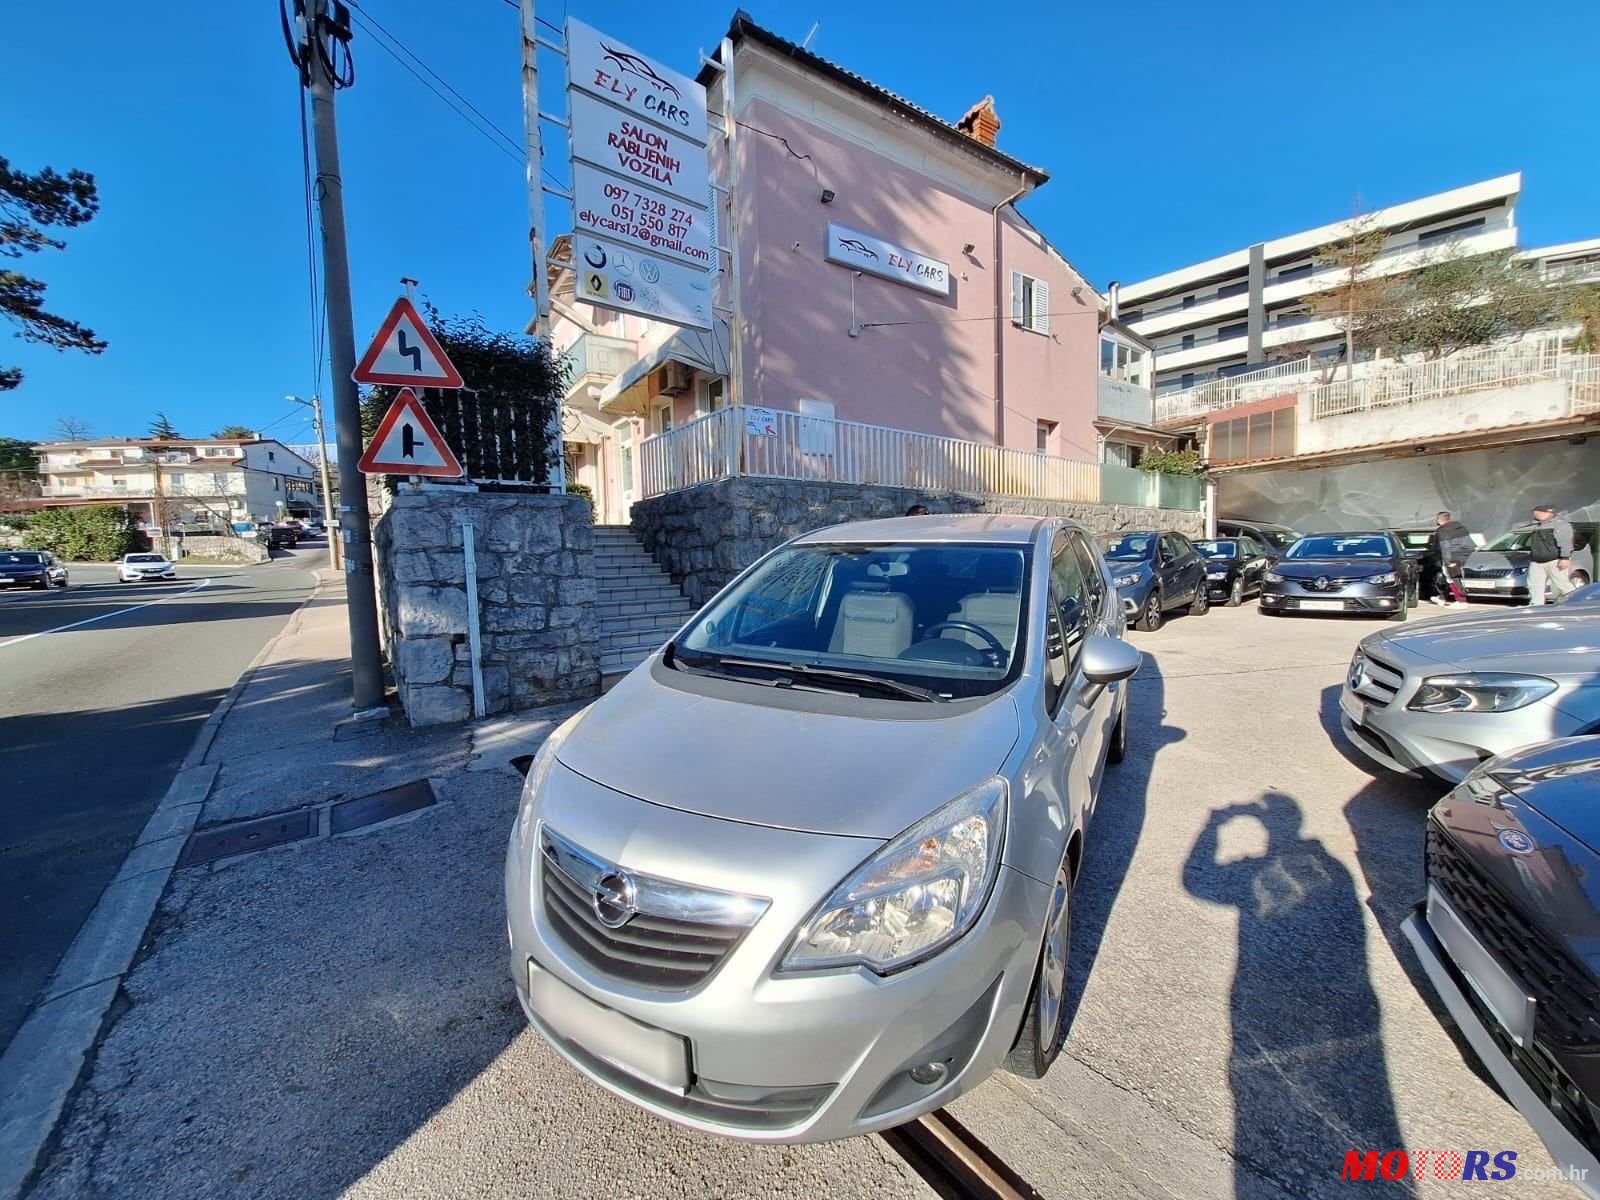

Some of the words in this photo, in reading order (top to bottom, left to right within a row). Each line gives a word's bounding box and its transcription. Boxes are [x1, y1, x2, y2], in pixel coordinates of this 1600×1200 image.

[593, 69, 638, 103] ELY
[644, 94, 690, 127] CARS
[607, 132, 681, 174] RABLJENIH
[620, 121, 668, 152] SALON
[618, 152, 673, 186] VOZILA
[603, 183, 629, 203] 097
[634, 193, 666, 217] 7328
[671, 208, 693, 227] 274
[611, 203, 634, 222] 051
[639, 213, 664, 232] 550
[668, 223, 688, 240] 817
[579, 209, 710, 261] elycars12@gmail.com
[888, 253, 913, 273] ELY
[916, 263, 944, 282] CARS
